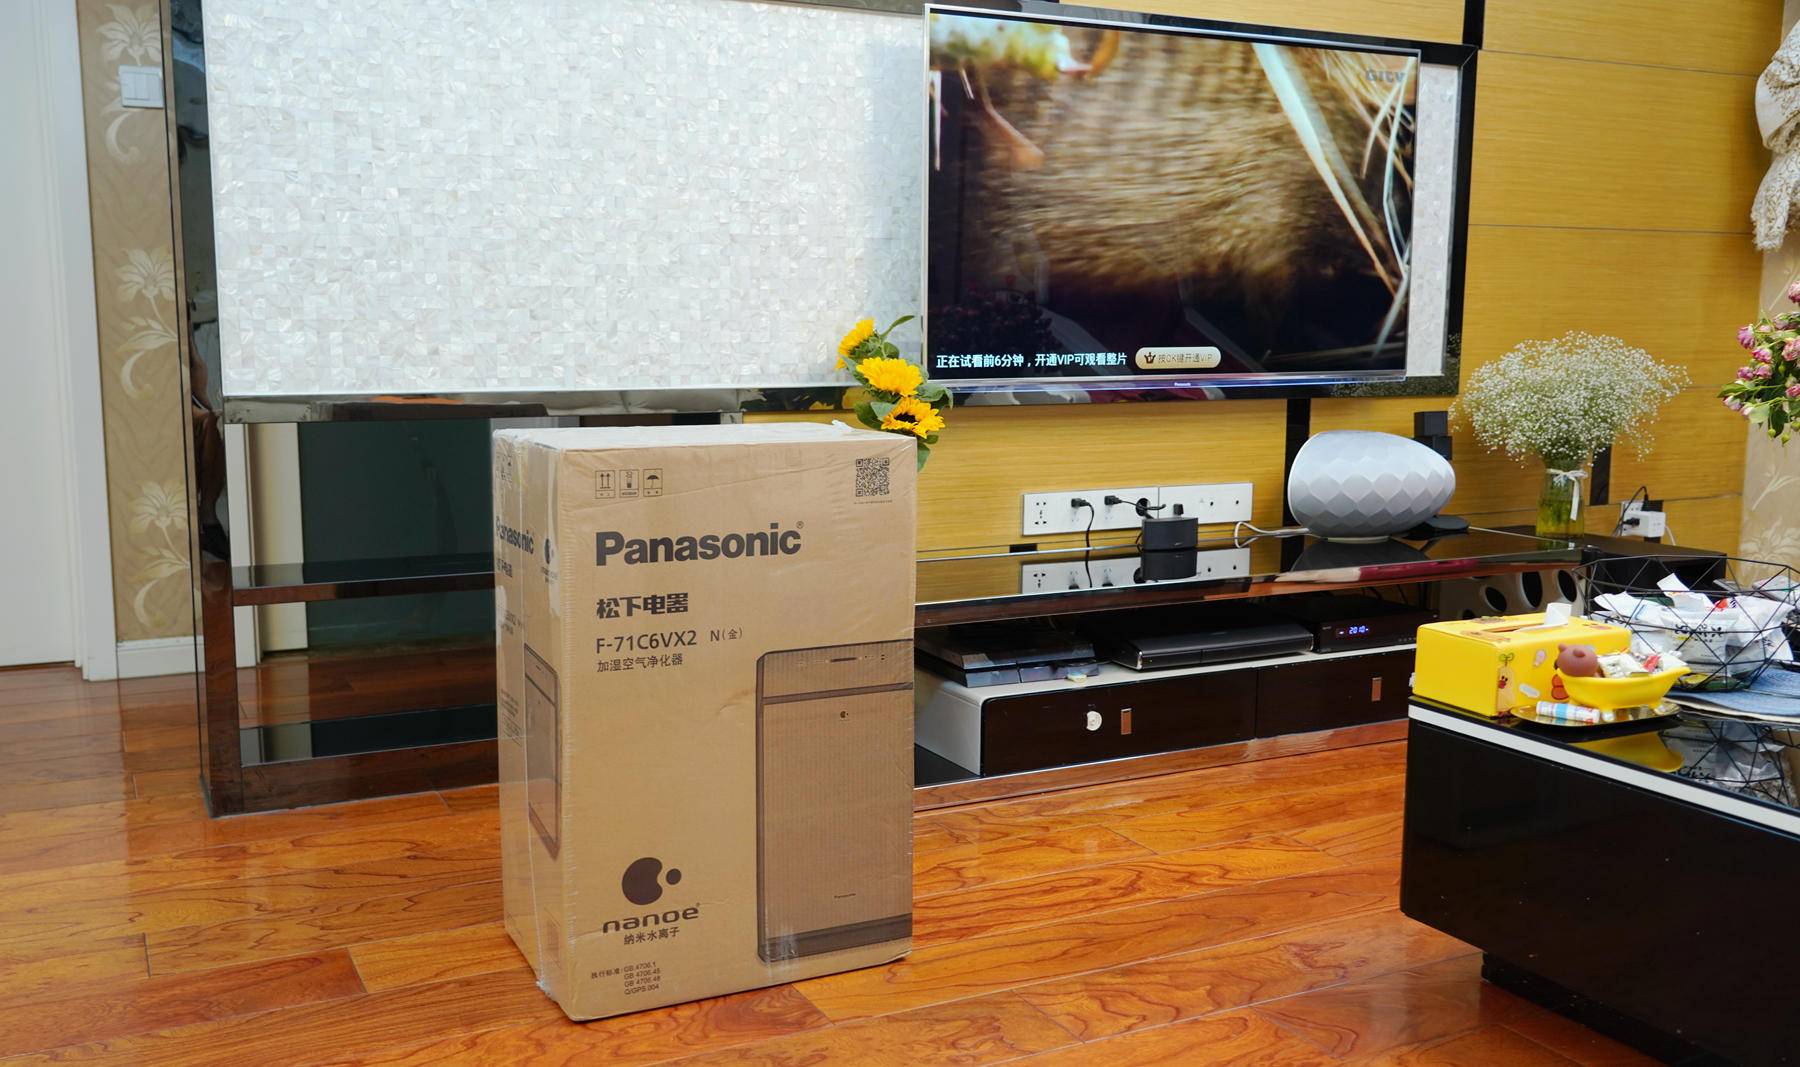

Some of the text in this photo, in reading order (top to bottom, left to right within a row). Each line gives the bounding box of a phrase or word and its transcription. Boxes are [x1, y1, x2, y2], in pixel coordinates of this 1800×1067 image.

[596, 522, 802, 567] Panasonic
[596, 592, 689, 619] 松下电器
[596, 630, 697, 654] F-71C6VX2
[597, 653, 683, 673] 加湿空气净化器
[602, 907, 699, 934] nanoe
[623, 926, 680, 946] 纳米水离子
[623, 965, 634, 973] GB
[623, 972, 635, 981] GB
[624, 980, 635, 988] GB
